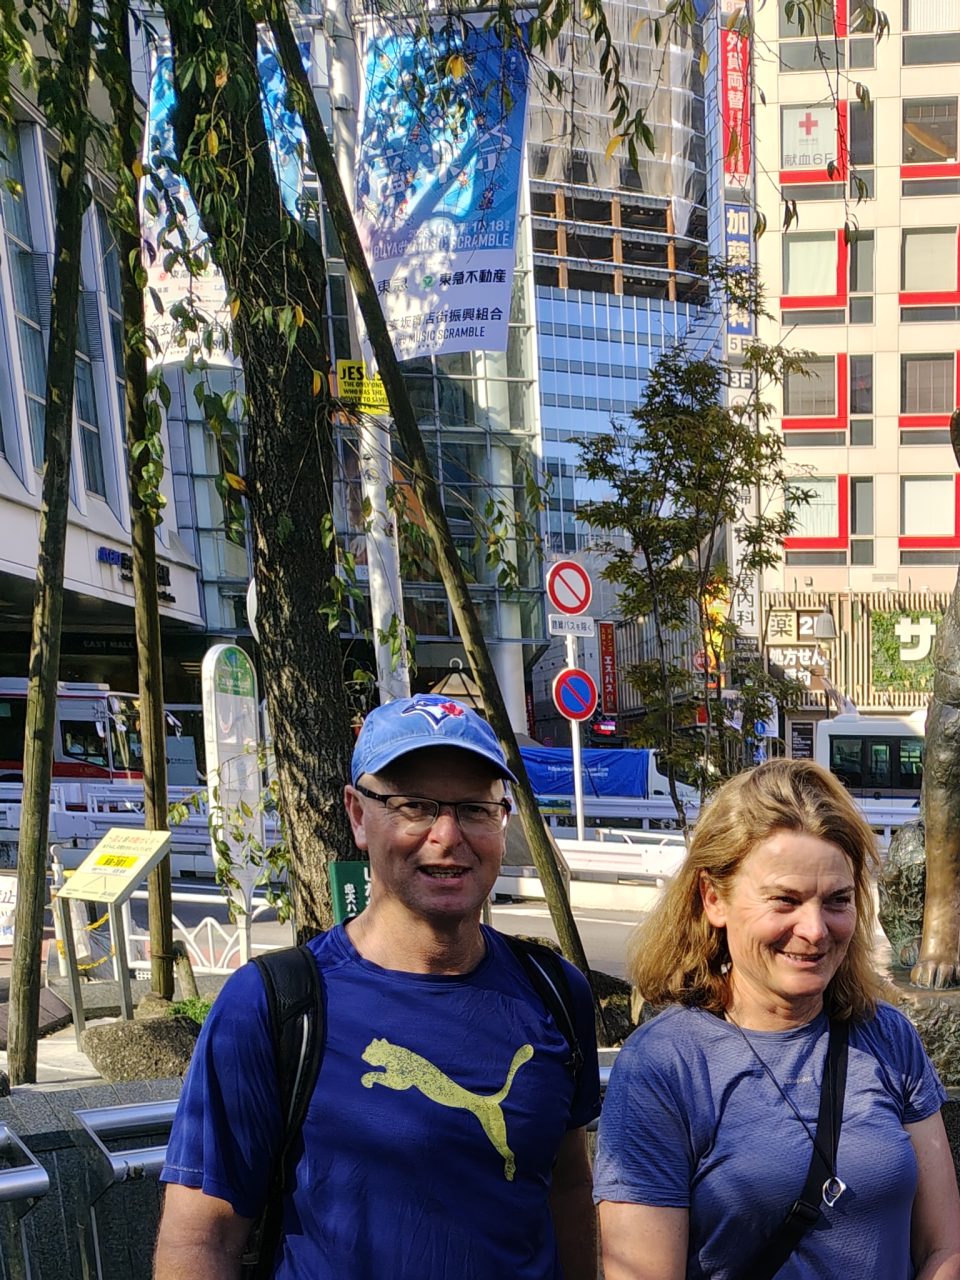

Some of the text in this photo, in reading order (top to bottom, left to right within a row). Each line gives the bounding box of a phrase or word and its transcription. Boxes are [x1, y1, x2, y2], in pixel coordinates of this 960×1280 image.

[726, 32, 744, 109] 外貨両替
[451, 232, 510, 249] SCRAMBLE
[439, 268, 507, 287] 東急不動産
[437, 325, 486, 340] SCRAMBLE
[730, 372, 751, 388] 3F
[770, 613, 793, 637] 薬
[770, 647, 825, 666] 処方せん
